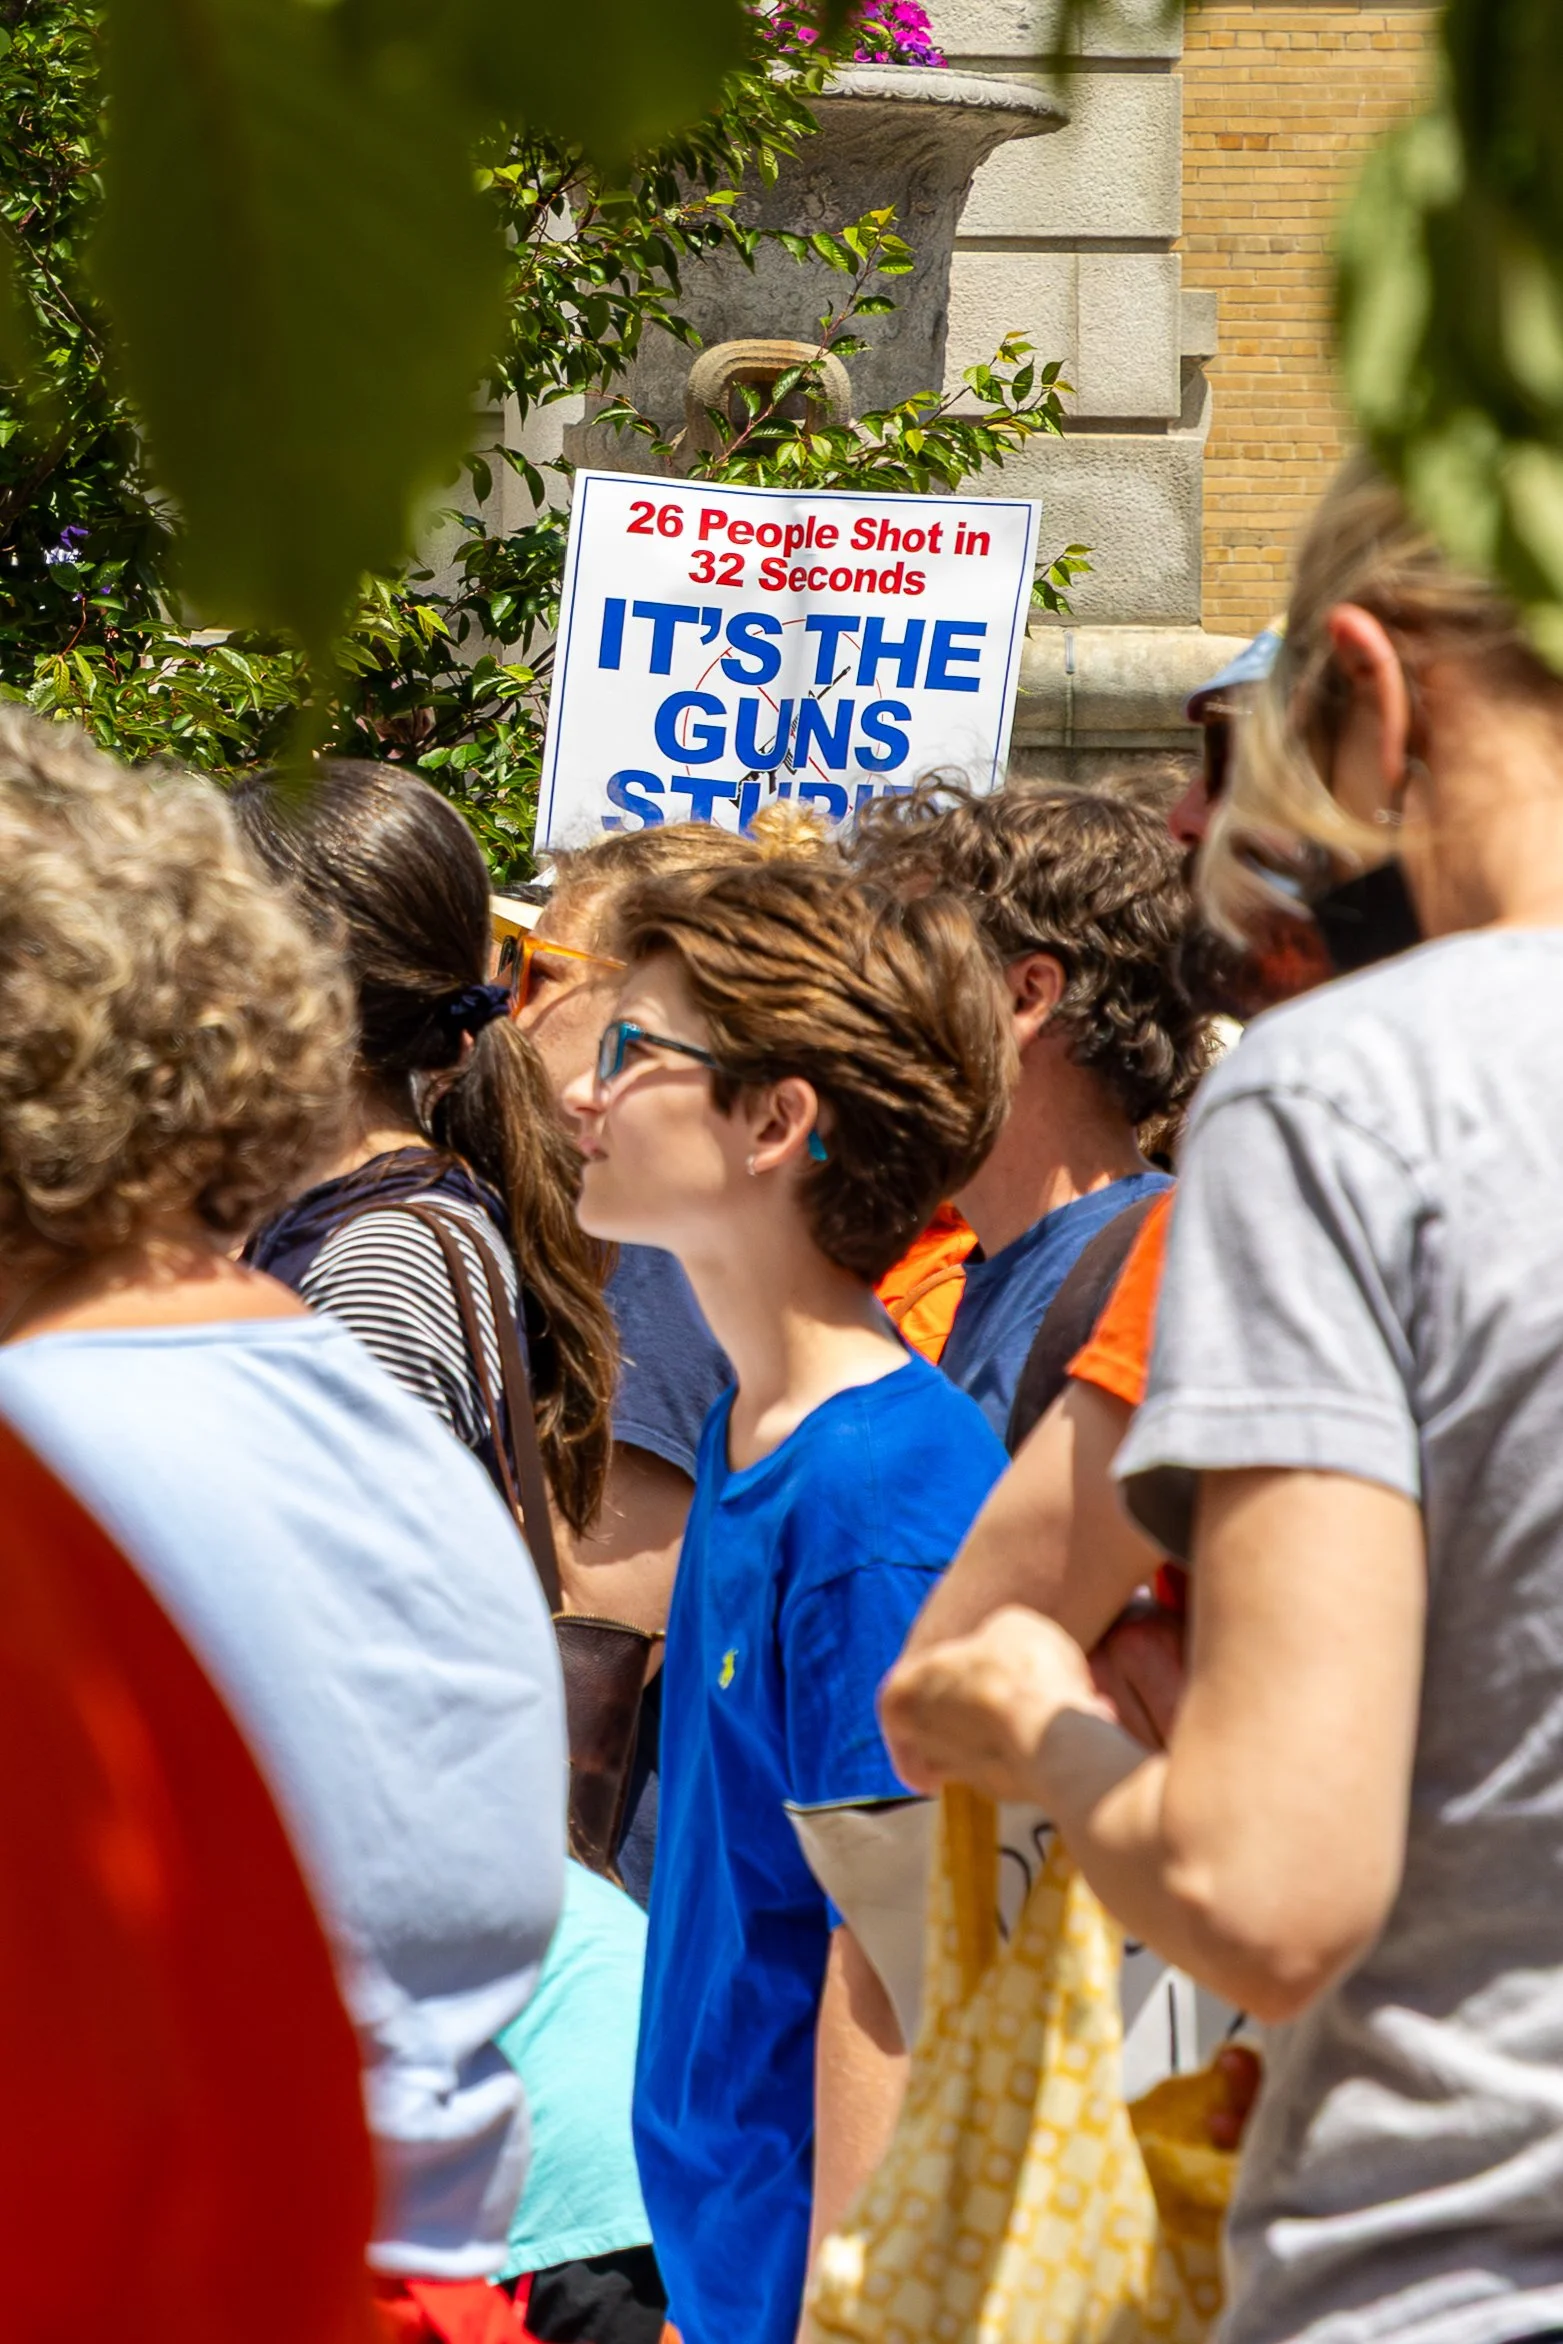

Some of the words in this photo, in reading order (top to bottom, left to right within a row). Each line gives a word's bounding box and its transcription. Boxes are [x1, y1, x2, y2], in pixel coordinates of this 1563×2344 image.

[626, 500, 684, 538] 26
[697, 508, 840, 559] People
[849, 517, 944, 555] Shot
[953, 521, 991, 556] in
[688, 549, 746, 588] 32
[757, 556, 927, 596] Seconds
[597, 597, 783, 687] IT'S
[804, 613, 989, 693] THE
[653, 690, 913, 773] GUNS
[601, 769, 916, 842] STUP
